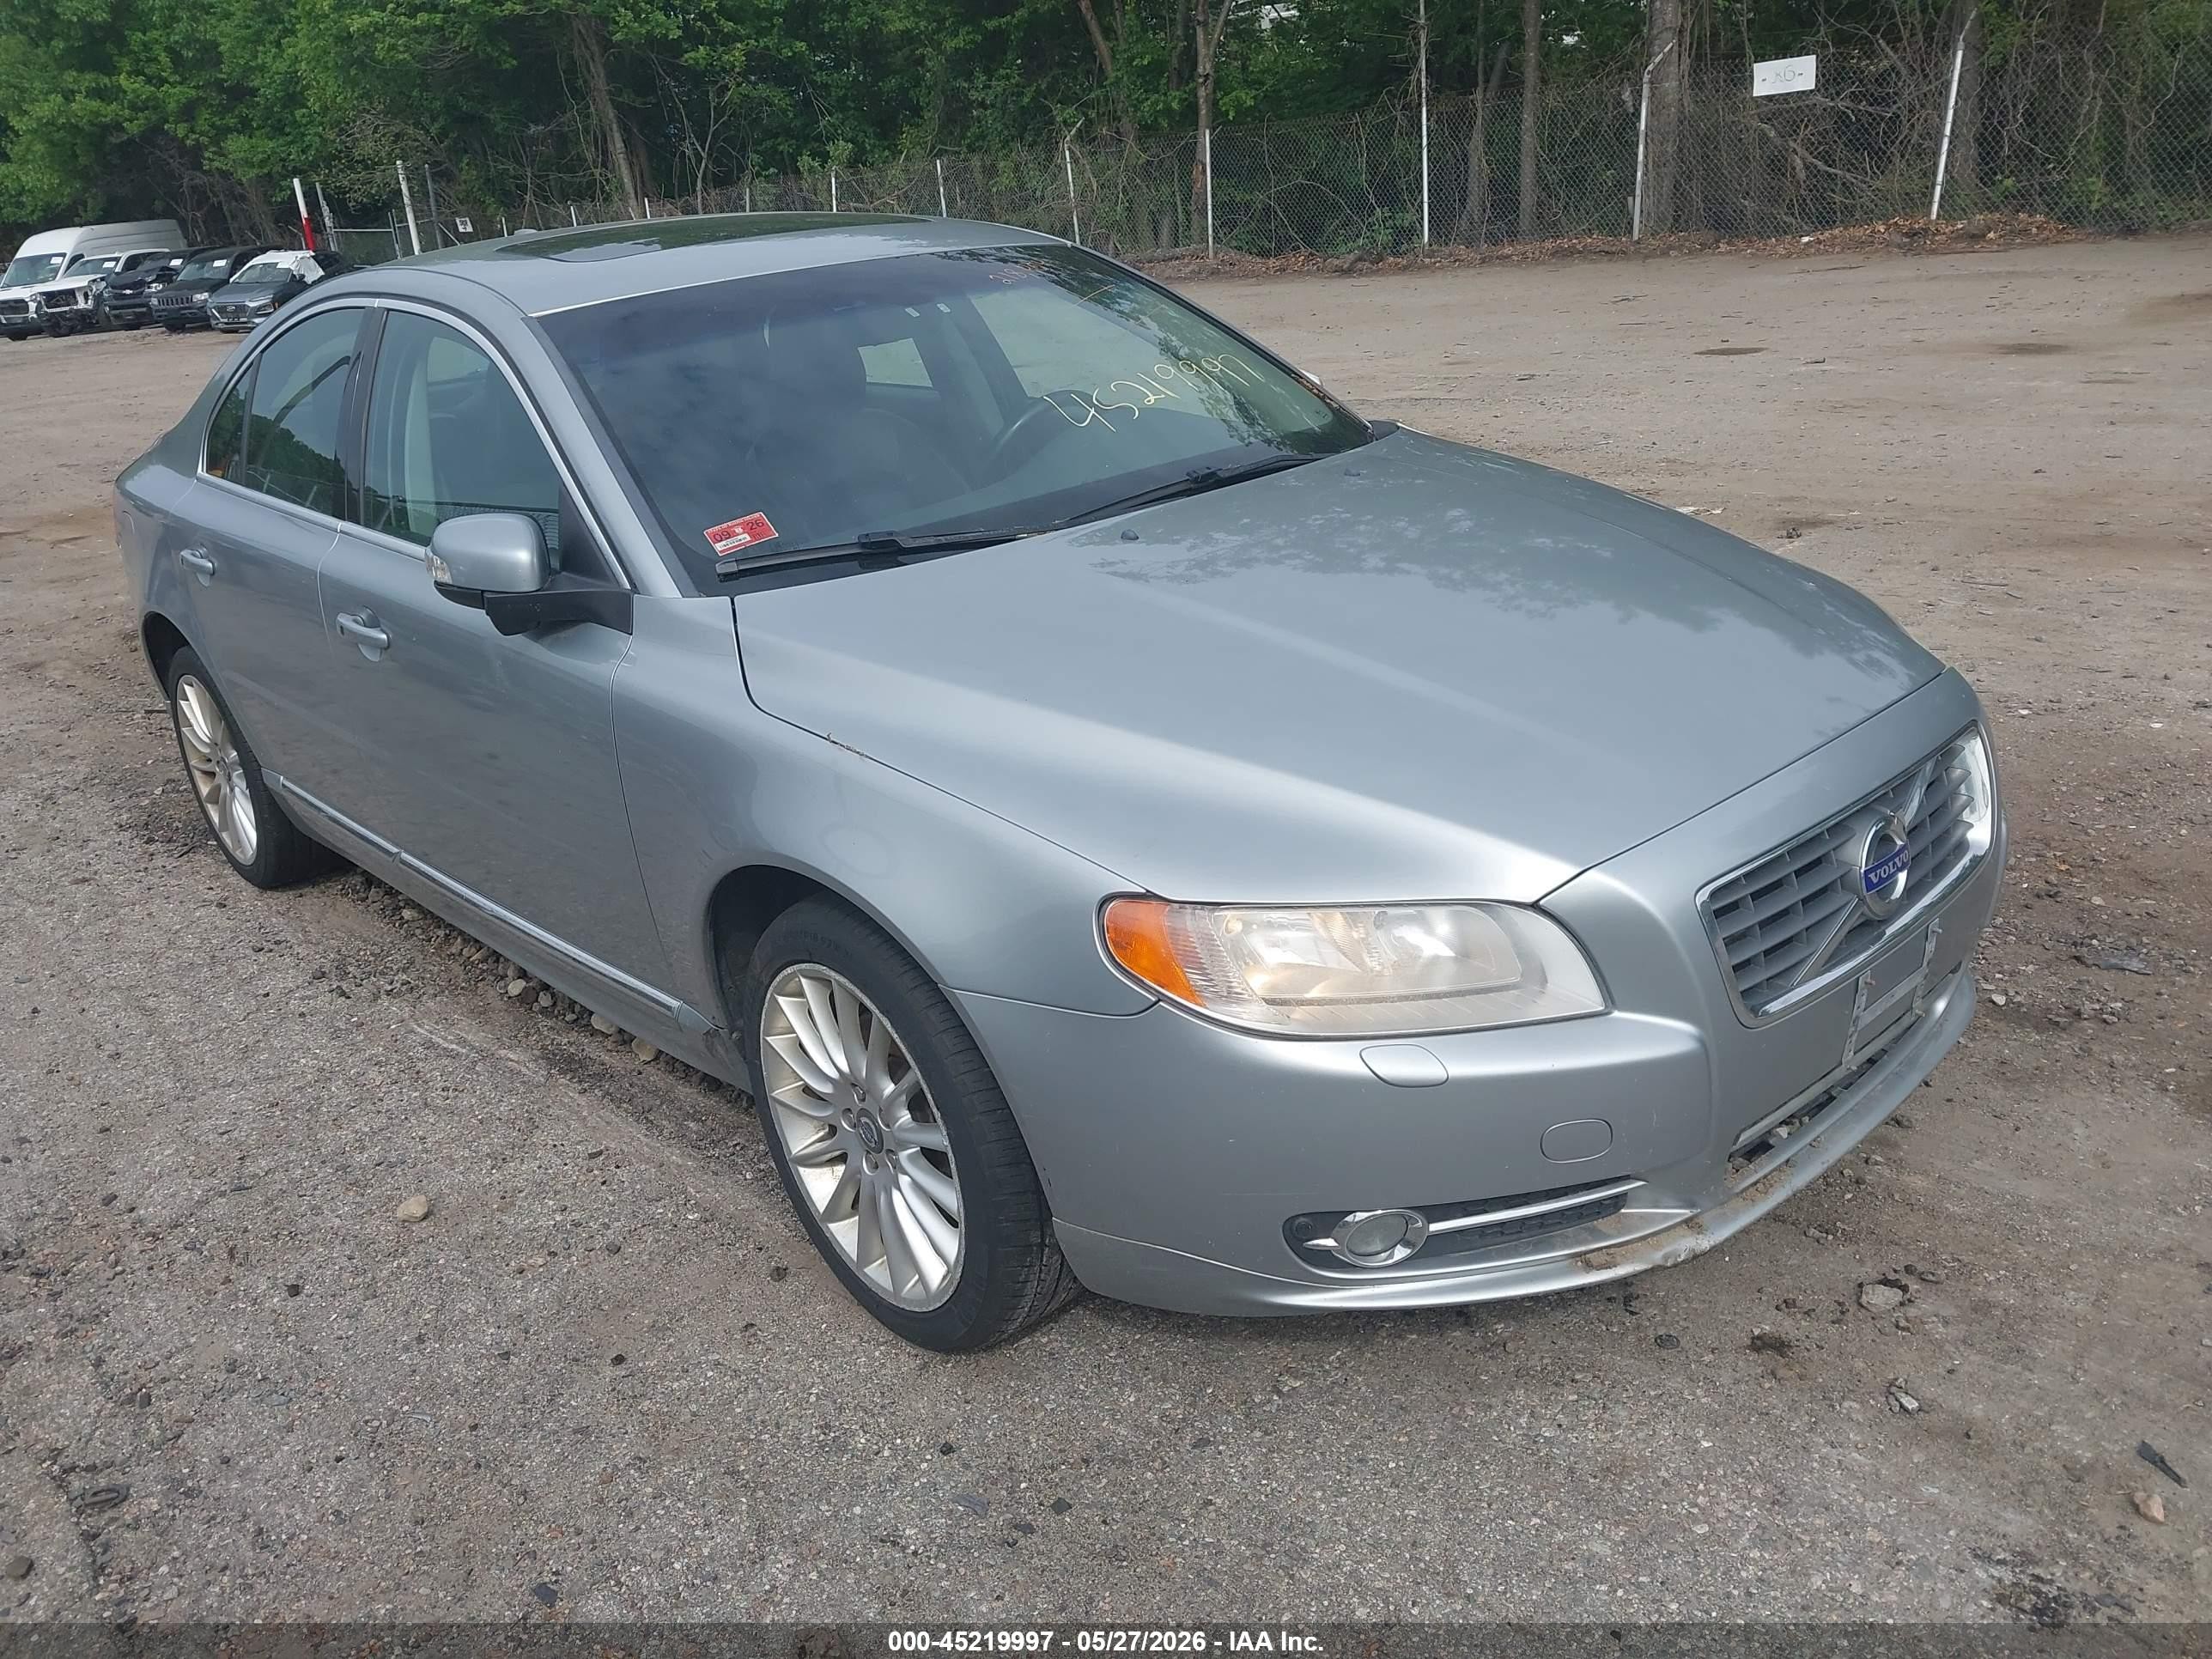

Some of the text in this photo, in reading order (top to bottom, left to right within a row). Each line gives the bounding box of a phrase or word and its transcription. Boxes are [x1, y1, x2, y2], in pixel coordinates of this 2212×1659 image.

[1043, 354, 1265, 432] 45219997
[713, 530, 731, 542] 09
[746, 519, 764, 531] 26
[1869, 850, 1909, 884] VOLVO
